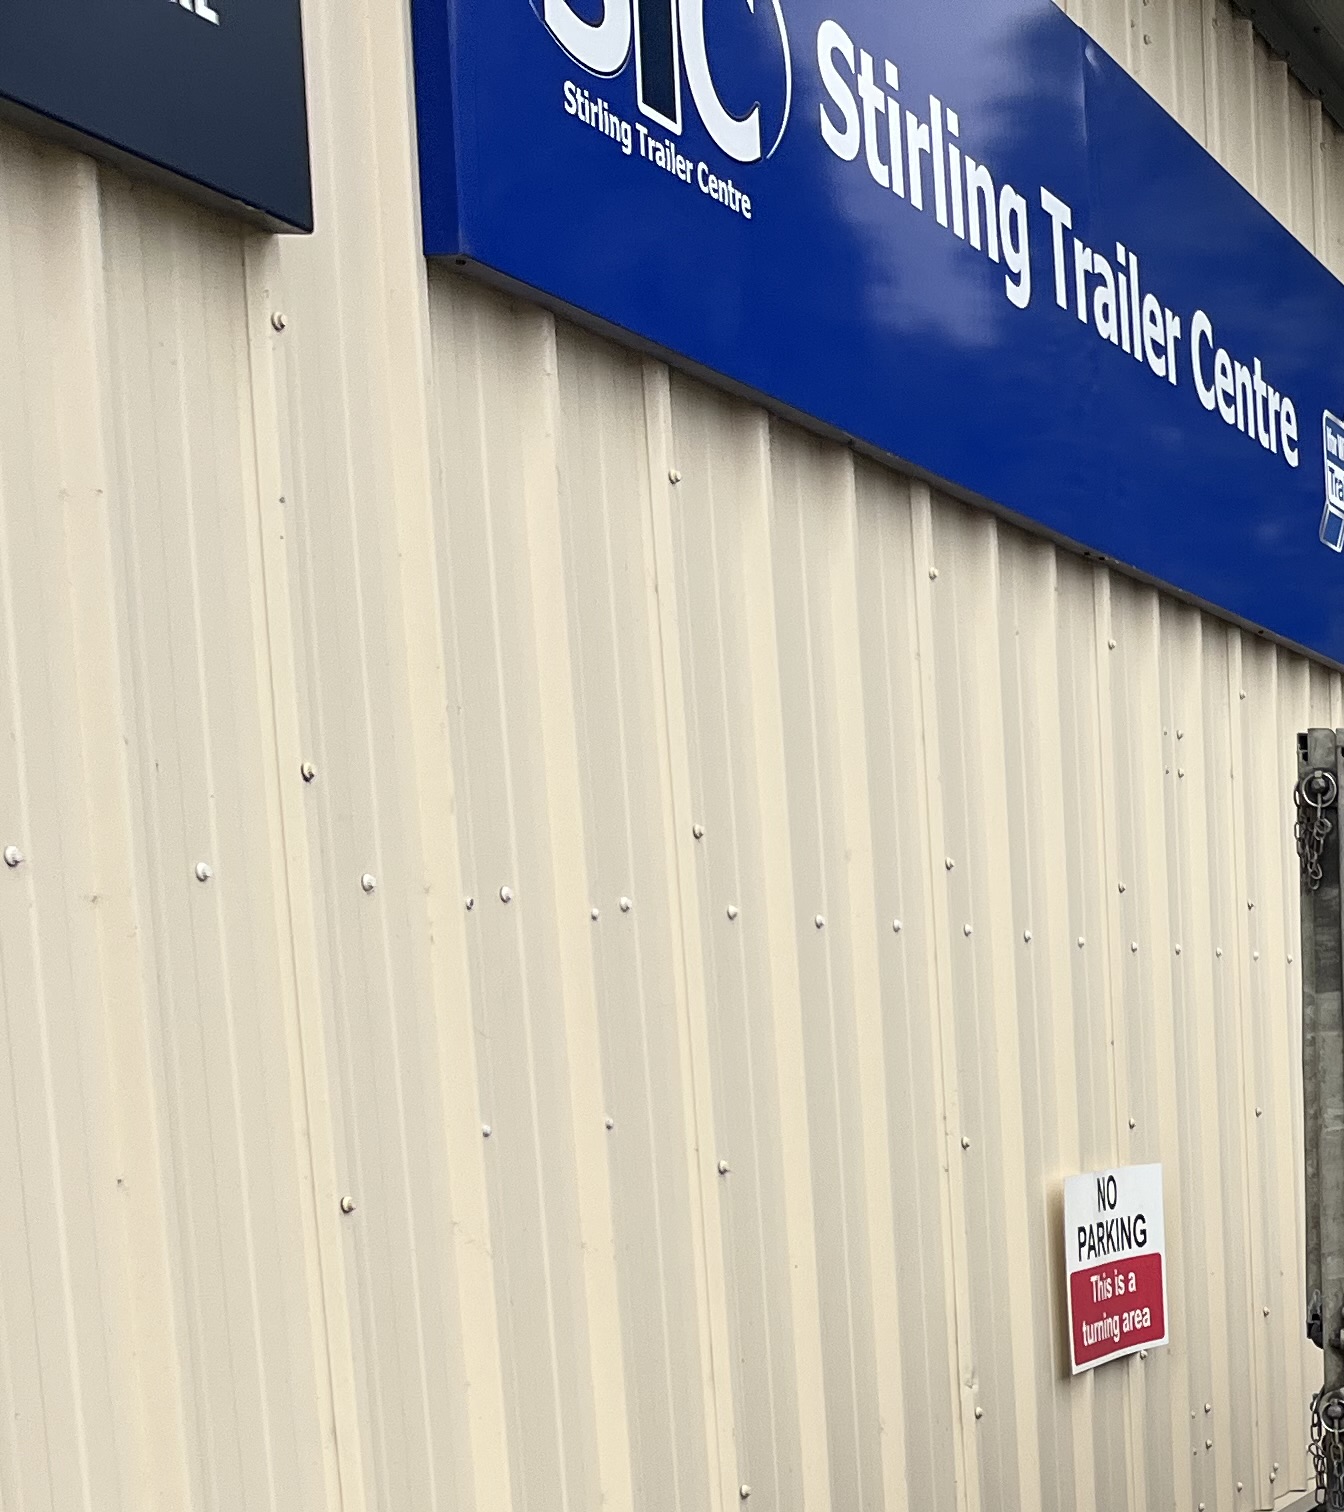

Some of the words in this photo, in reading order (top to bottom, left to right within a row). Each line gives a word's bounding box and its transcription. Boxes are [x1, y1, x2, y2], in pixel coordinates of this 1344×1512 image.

[563, 80, 632, 155] Stirling
[635, 122, 694, 184] Trailer
[697, 161, 752, 219] Centre
[818, 20, 1030, 309] Stirling
[1041, 186, 1182, 386] Trailer
[1190, 309, 1300, 468] Centre
[1096, 1175, 1117, 1212] NO
[1077, 1213, 1147, 1262] PARKING
[1090, 1272, 1112, 1303] This
[1114, 1269, 1125, 1296] is
[1128, 1272, 1136, 1292] a
[1082, 1312, 1120, 1347] turning
[1122, 1306, 1151, 1334] area
